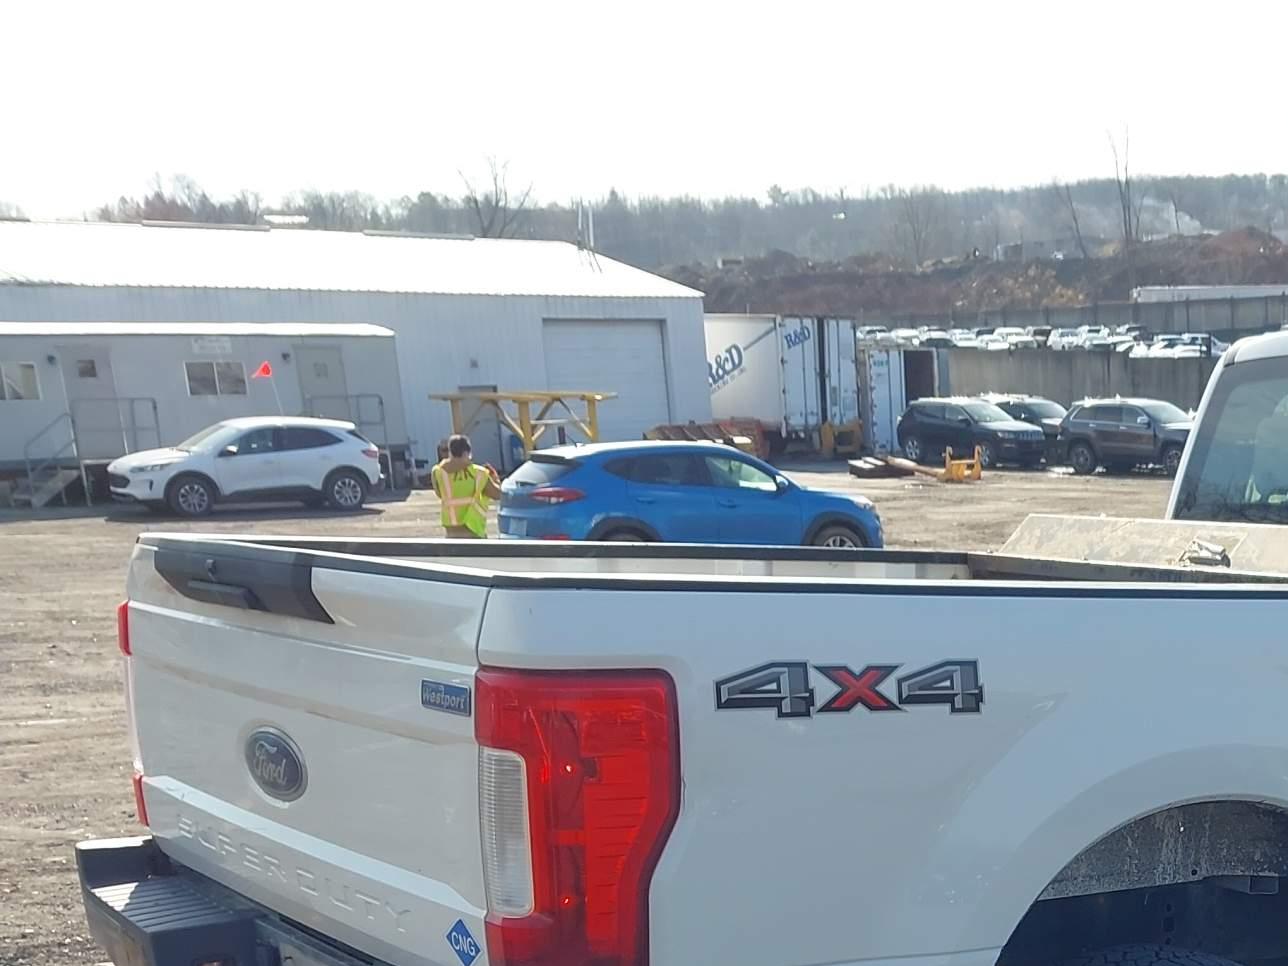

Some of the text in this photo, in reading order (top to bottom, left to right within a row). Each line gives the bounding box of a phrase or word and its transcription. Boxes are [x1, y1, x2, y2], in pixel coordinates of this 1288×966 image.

[784, 326, 811, 349] R&D
[423, 684, 466, 710] Westport
[253, 740, 288, 785] Ford
[178, 816, 412, 933] SUPER DUTY
[451, 931, 476, 957] CNG
